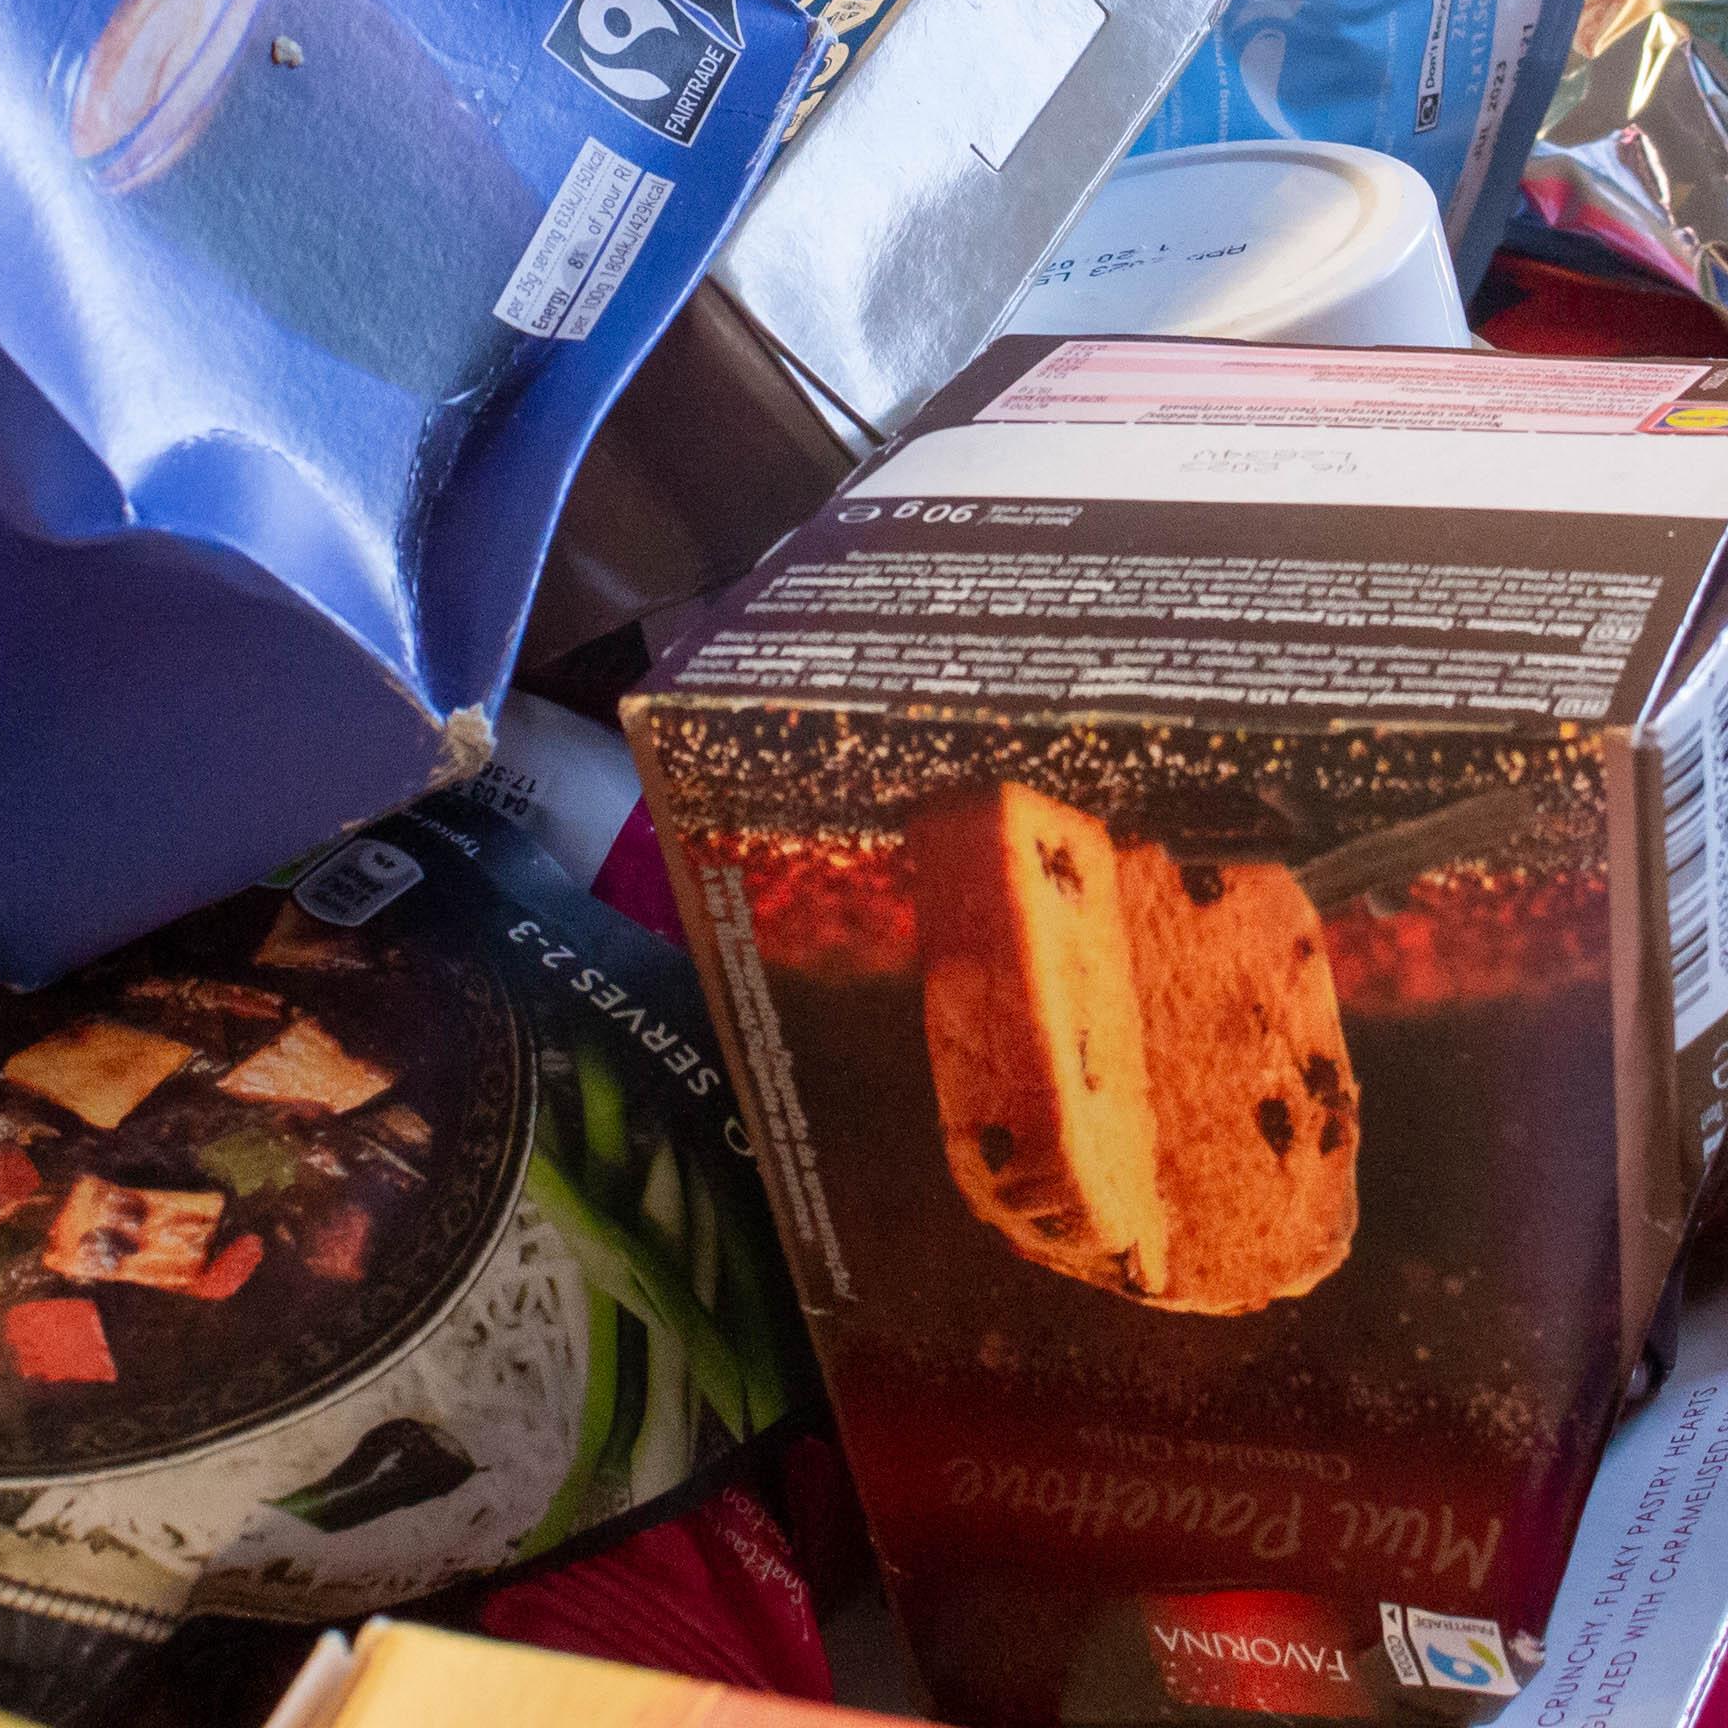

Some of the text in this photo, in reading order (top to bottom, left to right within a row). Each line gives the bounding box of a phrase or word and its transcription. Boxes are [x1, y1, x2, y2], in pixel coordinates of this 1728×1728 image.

[663, 41, 729, 141] FAIRTRADE
[525, 225, 567, 274] serving
[529, 162, 633, 335] Energy 8% of your RI
[513, 268, 544, 299] 35g
[922, 501, 978, 525] 90
[505, 910, 725, 1102] SERVES 2-3
[1534, 1377, 1719, 1728] CRUNCHY, FLAKY PASTRY HEARTS
[1620, 1583, 1667, 1649] WITH
[1153, 1621, 1349, 1684] FAVORINA
